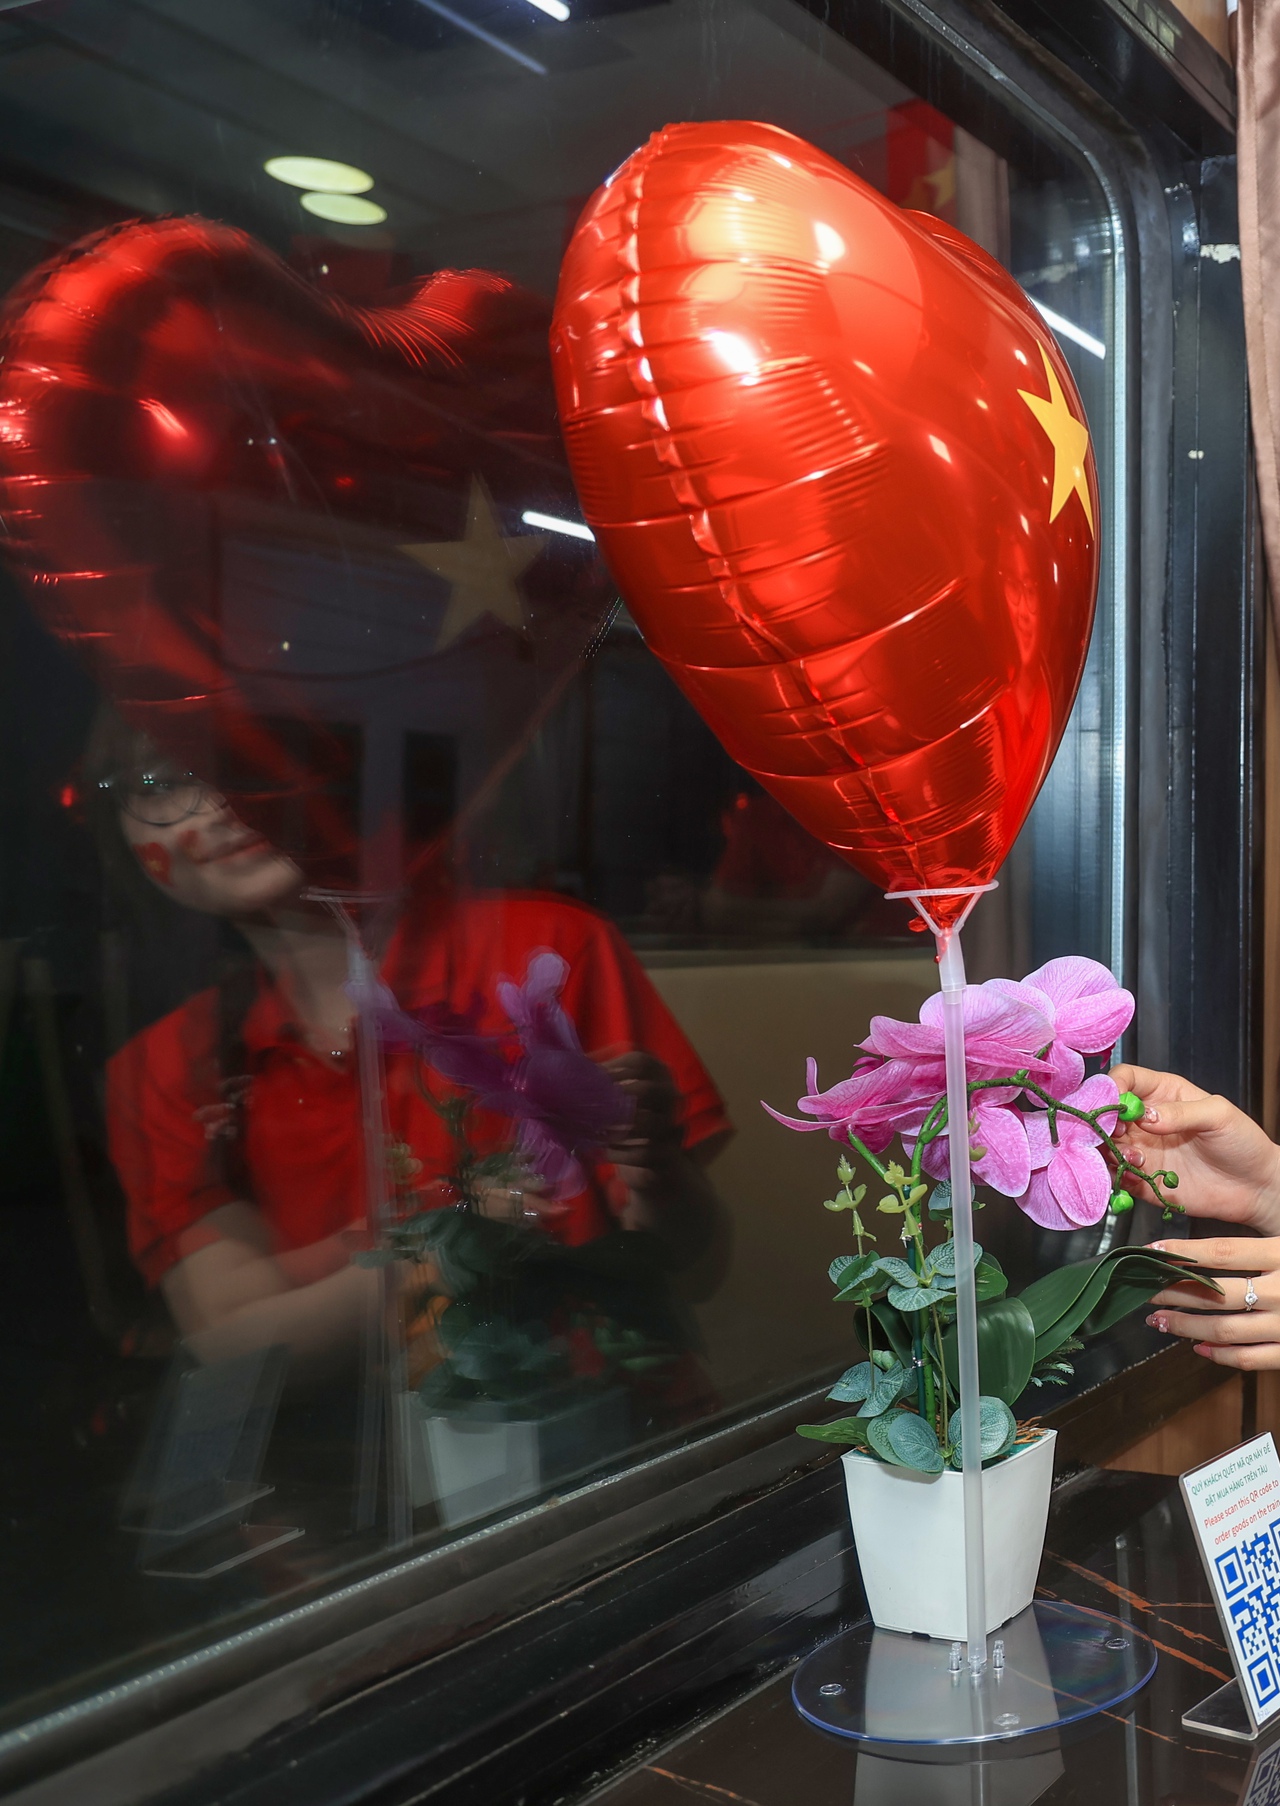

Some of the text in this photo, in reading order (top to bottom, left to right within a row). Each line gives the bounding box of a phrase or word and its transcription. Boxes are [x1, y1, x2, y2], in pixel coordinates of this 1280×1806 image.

[1204, 1473, 1222, 1488] KHÁCH
[1246, 1455, 1254, 1465] QR
[1253, 1448, 1264, 1460] NÀY
[1216, 1487, 1229, 1500] MUA
[1229, 1479, 1245, 1493] HÀNG
[1244, 1470, 1258, 1485] TRÊN
[1258, 1465, 1268, 1476] TÀU
[1204, 1479, 1279, 1528] Please scan this QR code to
[1215, 1499, 1280, 1545] order goods on the train
